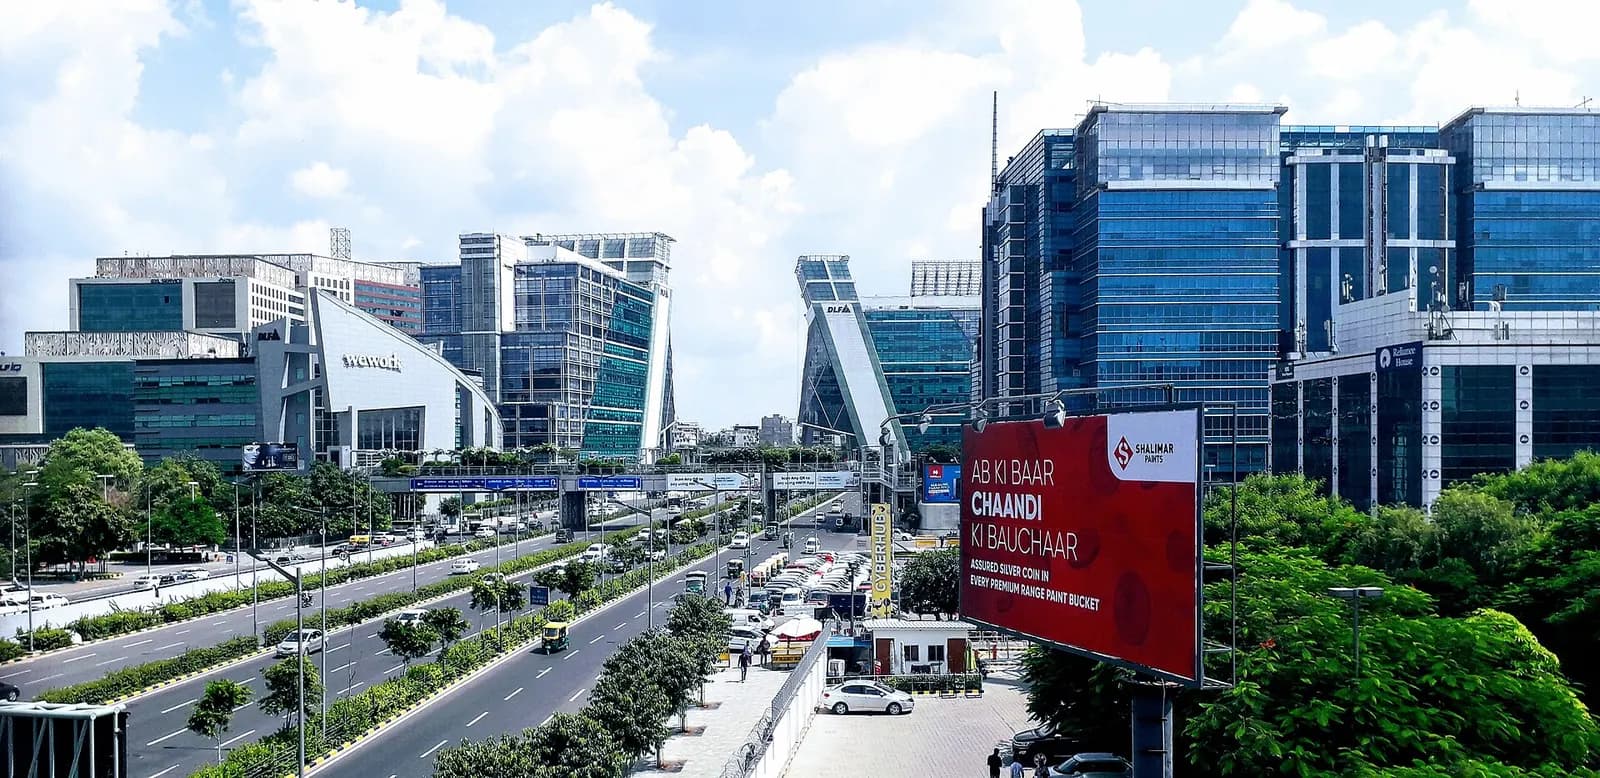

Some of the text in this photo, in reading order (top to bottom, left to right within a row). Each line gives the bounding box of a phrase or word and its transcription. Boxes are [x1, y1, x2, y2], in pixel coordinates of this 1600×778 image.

[1395, 357, 1413, 367] House
[1135, 443, 1175, 454] SHALIMAR
[1144, 455, 1164, 463] PAINTS
[971, 459, 1055, 487] AB KI BAAR
[971, 491, 1042, 521] CHAANDI
[874, 513, 887, 592] CYBERHUB
[971, 523, 1078, 561] KI BAUCHAAR
[970, 558, 1049, 582] ASSURED SILVER COIN IN
[970, 574, 1101, 611] EVERY PREMIUM RANGE PAINT BUCKET
